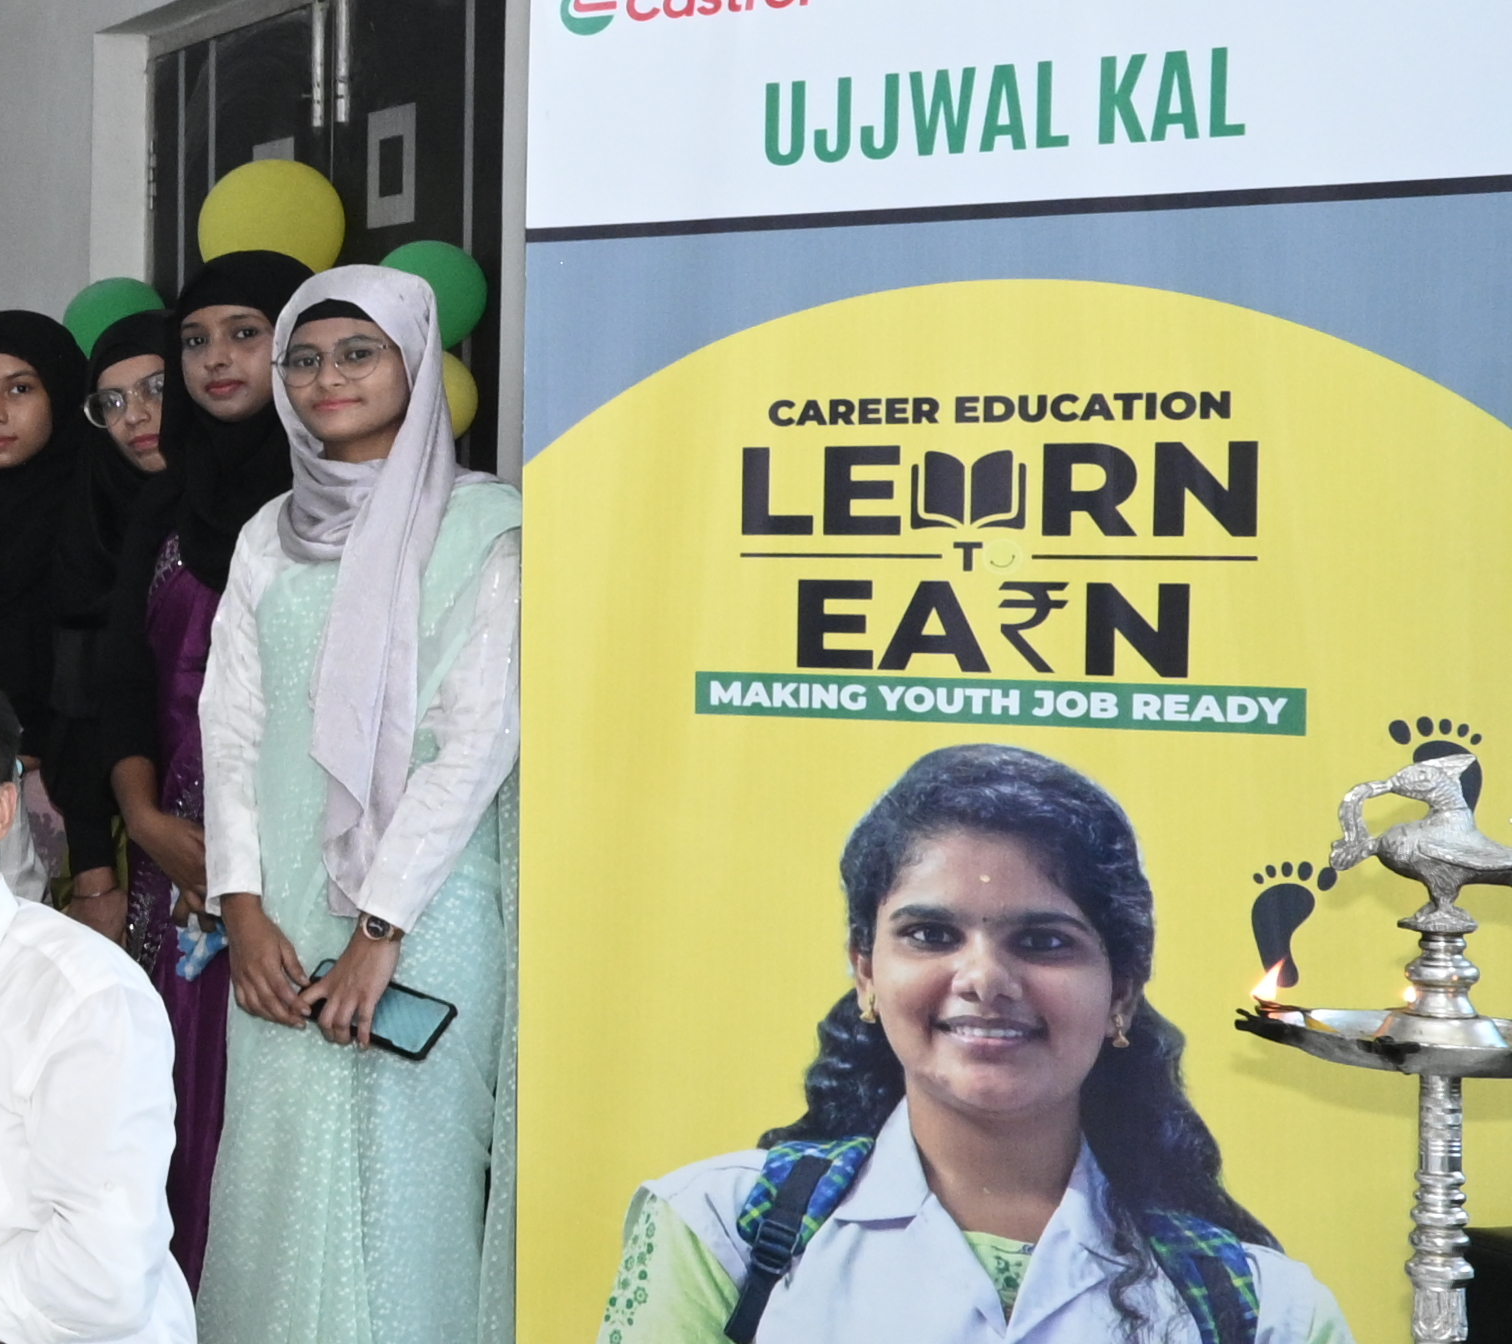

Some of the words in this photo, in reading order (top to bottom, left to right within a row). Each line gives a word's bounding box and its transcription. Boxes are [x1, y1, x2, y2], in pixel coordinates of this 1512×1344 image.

[763, 60, 1071, 167] UJJWAL
[1098, 46, 1247, 147] KAL
[767, 394, 940, 428] CAREER
[953, 390, 1233, 425] EDUCATION
[709, 678, 869, 713] MAKING
[877, 683, 1021, 719] YOUTH
[1033, 689, 1120, 722] JOB
[1131, 691, 1289, 728] READY
